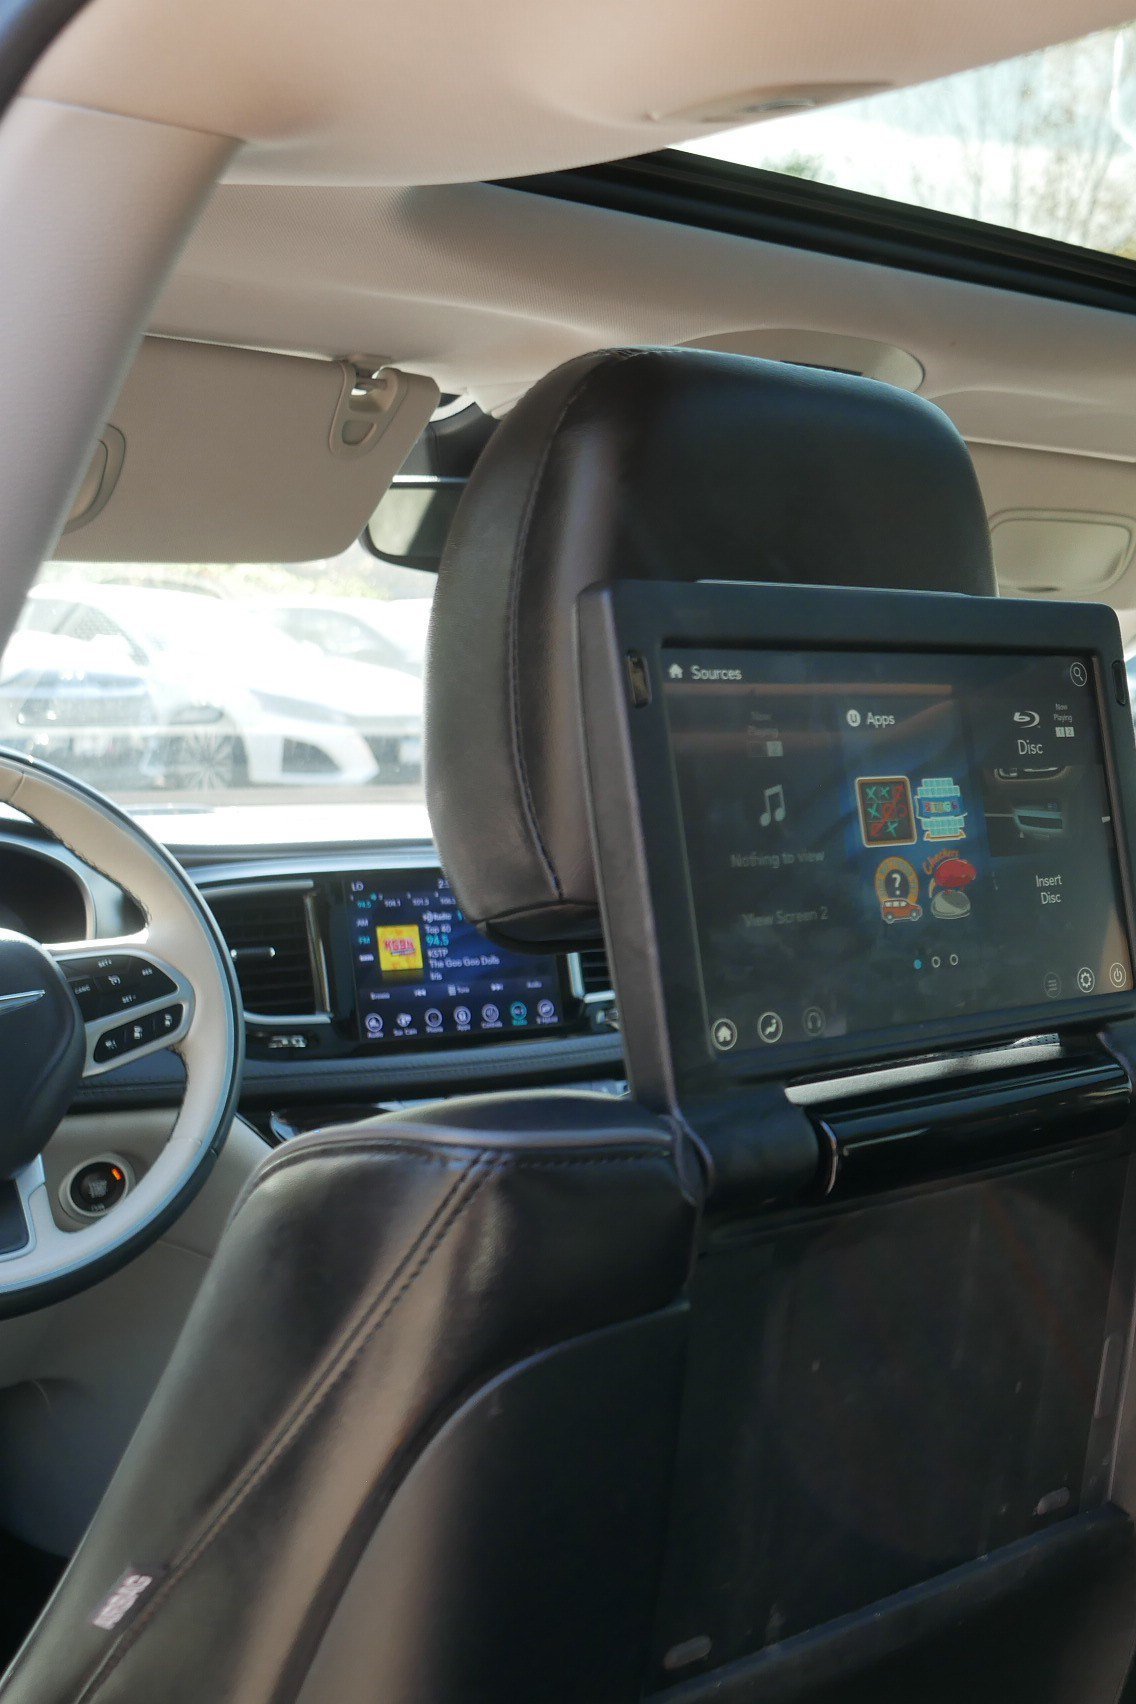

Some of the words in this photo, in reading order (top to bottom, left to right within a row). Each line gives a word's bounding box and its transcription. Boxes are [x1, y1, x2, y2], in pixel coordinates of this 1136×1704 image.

[690, 665, 742, 681] Sources
[866, 712, 895, 728] Apps
[1053, 714, 1073, 723] Playing
[1017, 739, 1043, 755] Disc
[782, 852, 795, 864] to
[1035, 874, 1062, 888] Insert
[1041, 891, 1062, 905] Disc
[820, 906, 829, 920] 2
[429, 959, 444, 968] The
[445, 958, 463, 968] Goo
[463, 957, 480, 967] Goo
